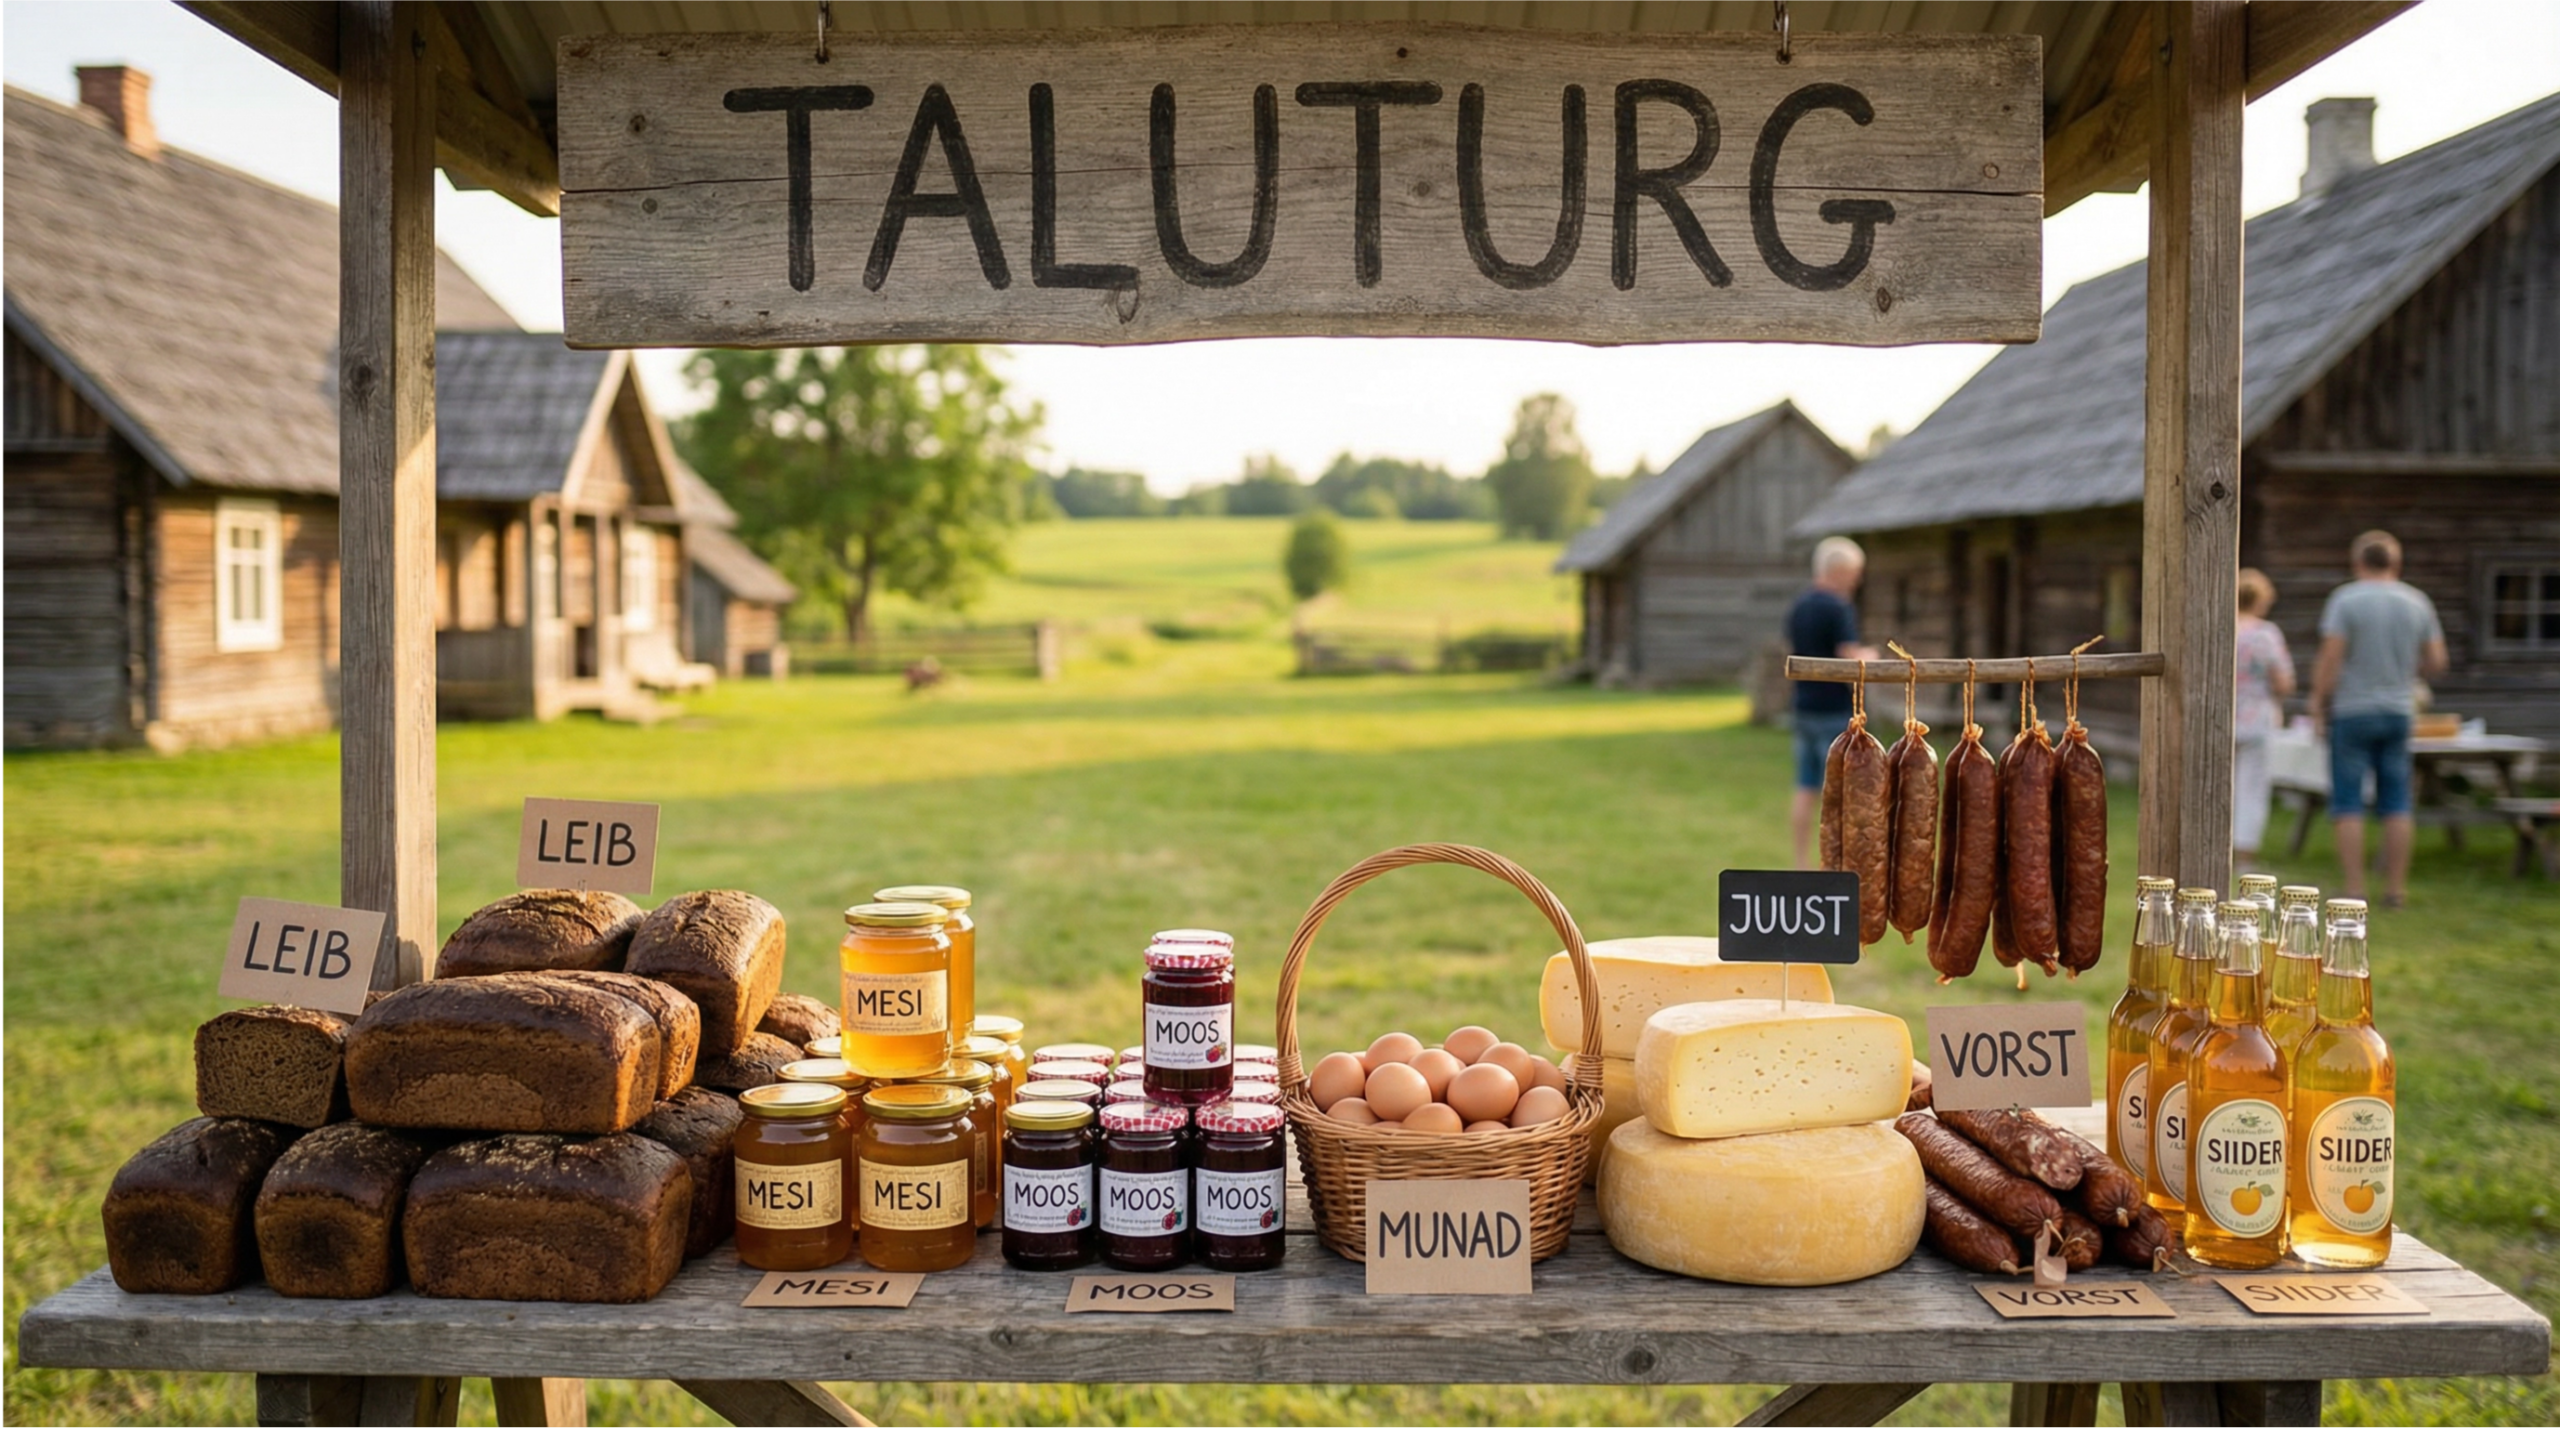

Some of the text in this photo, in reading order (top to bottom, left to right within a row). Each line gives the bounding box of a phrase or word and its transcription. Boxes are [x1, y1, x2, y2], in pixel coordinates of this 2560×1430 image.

[722, 78, 1896, 291] TALUTURG
[539, 820, 635, 866] LEIB
[1729, 893, 1849, 936] JUUST
[243, 921, 352, 980] LEIB
[857, 988, 922, 1017] MESI
[1156, 1019, 1219, 1044] MOOS
[1940, 1029, 2077, 1078] VORST
[2207, 1138, 2282, 1165] SIIDER
[2319, 1136, 2392, 1163] SIIDER
[748, 1178, 813, 1210] MESI
[875, 1179, 941, 1210] MESI
[1014, 1182, 1079, 1208] MOOS
[1110, 1186, 1175, 1211] MOOS
[1207, 1185, 1272, 1210] MOOS
[1379, 1211, 1522, 1259] MUNAD
[773, 1279, 890, 1295] MESI
[1090, 1284, 1214, 1300] MOOS
[1997, 1288, 2140, 1307] VORST
[2243, 1284, 2401, 1303] SIIDER
